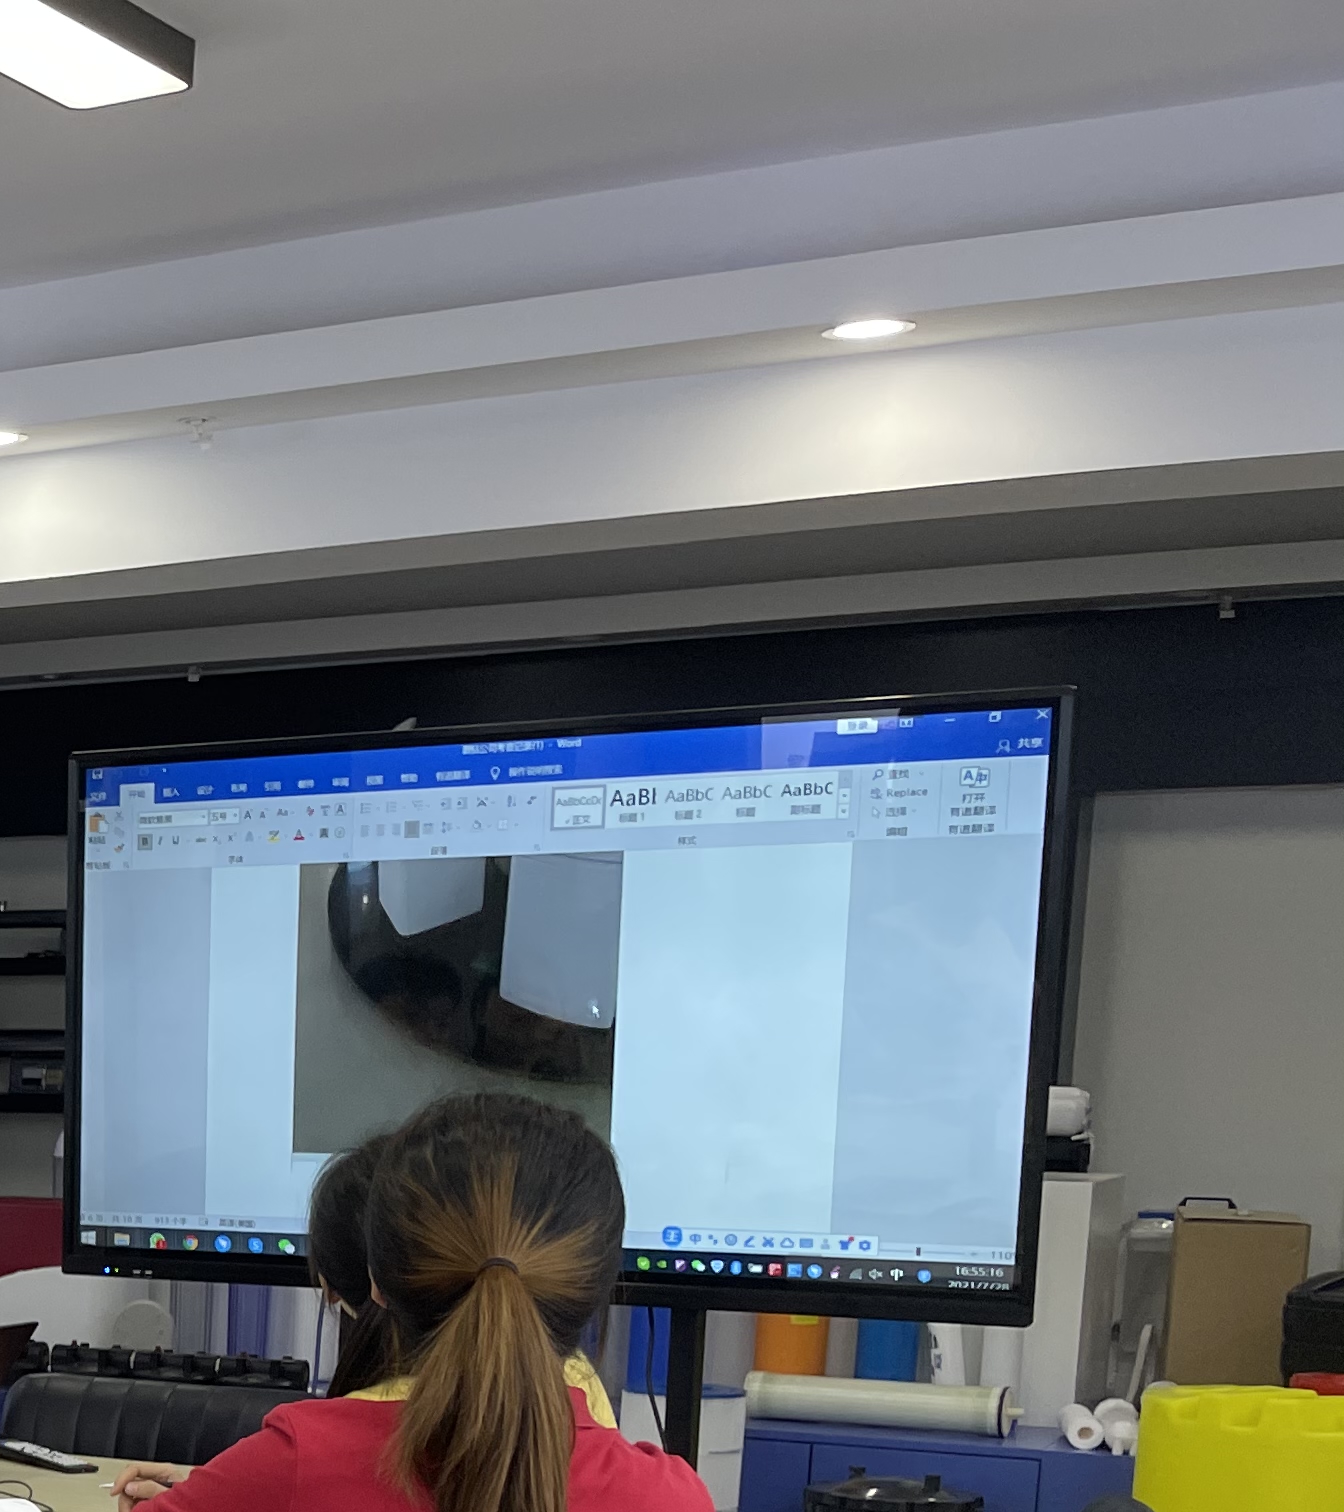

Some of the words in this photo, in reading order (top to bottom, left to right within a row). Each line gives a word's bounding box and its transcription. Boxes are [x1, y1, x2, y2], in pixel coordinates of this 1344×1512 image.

[1017, 737, 1044, 749] 共享
[886, 788, 928, 798] Replace
[955, 1265, 1004, 1277] 16:55:16
[948, 1280, 1010, 1291] 2021/7/28
